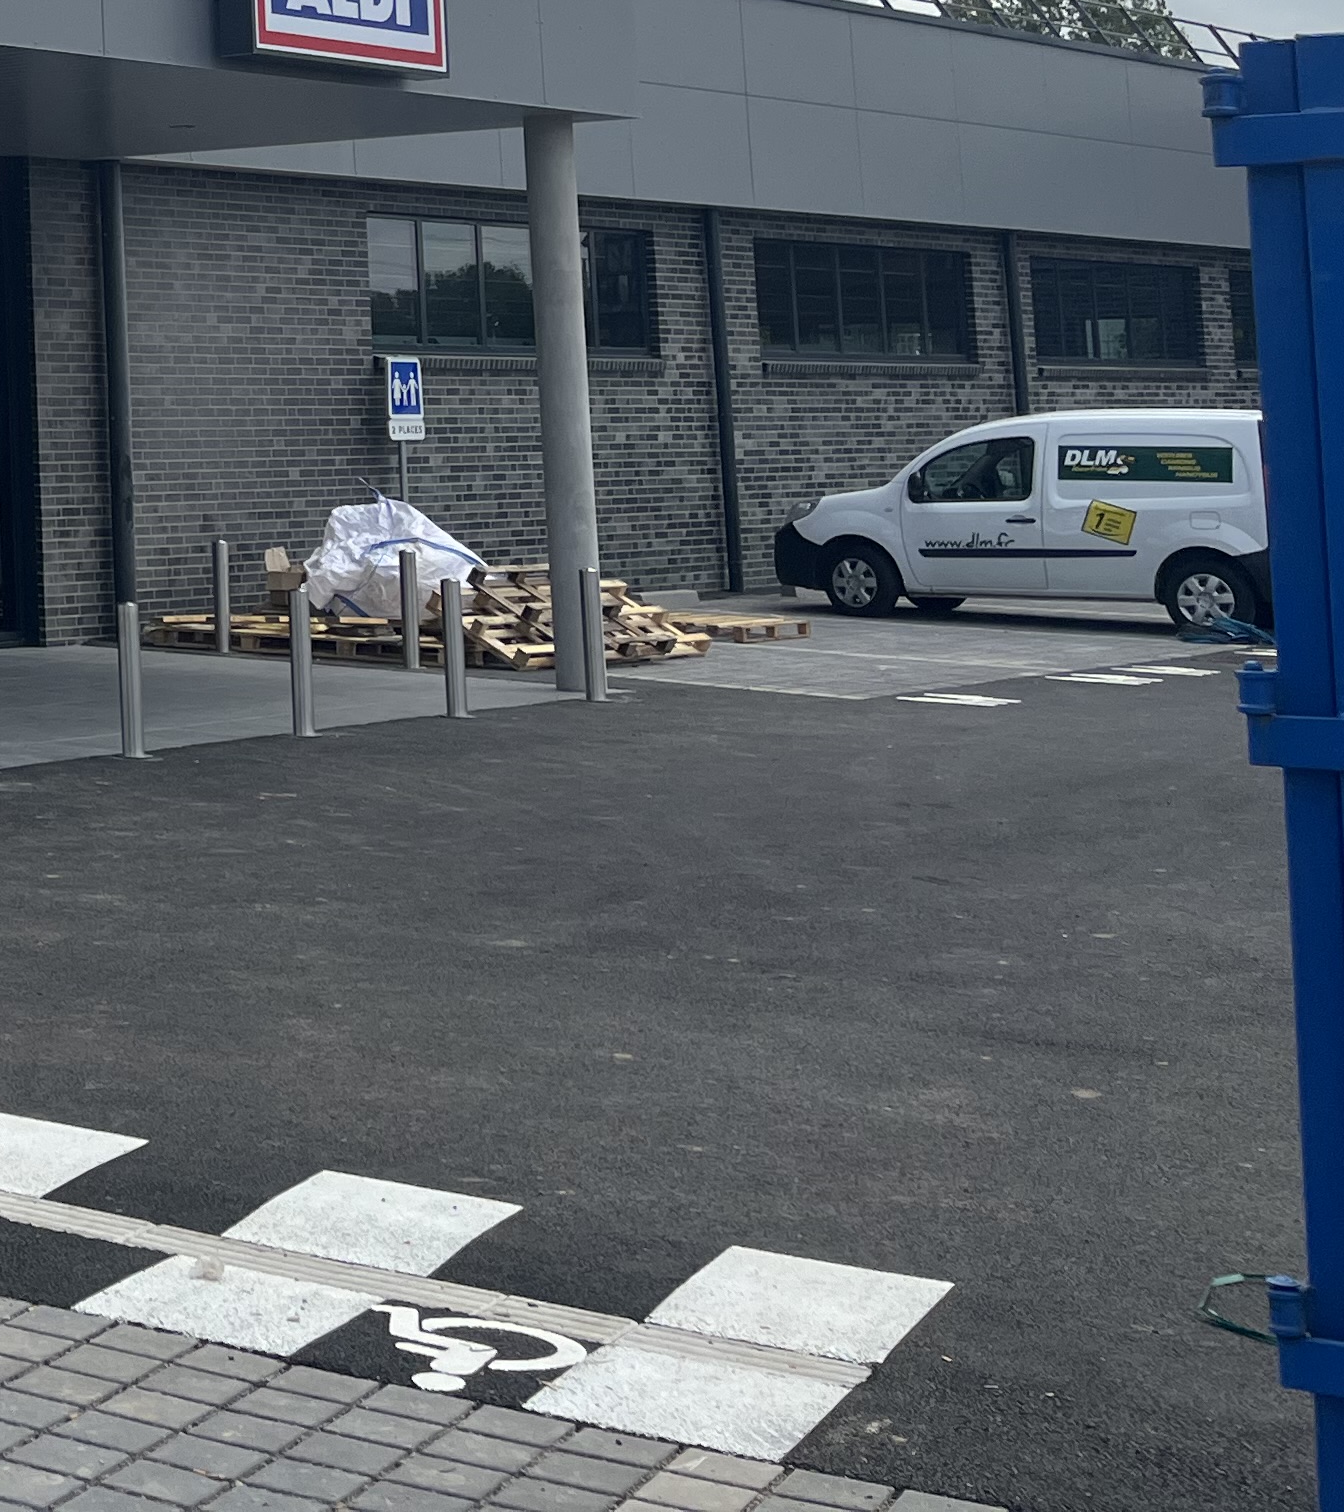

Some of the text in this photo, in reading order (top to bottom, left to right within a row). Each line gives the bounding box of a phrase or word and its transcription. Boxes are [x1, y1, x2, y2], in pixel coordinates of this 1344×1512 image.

[398, 425, 423, 434] PLACES
[1063, 449, 1118, 466] DLM
[925, 531, 1015, 548] www.dlm.fr
